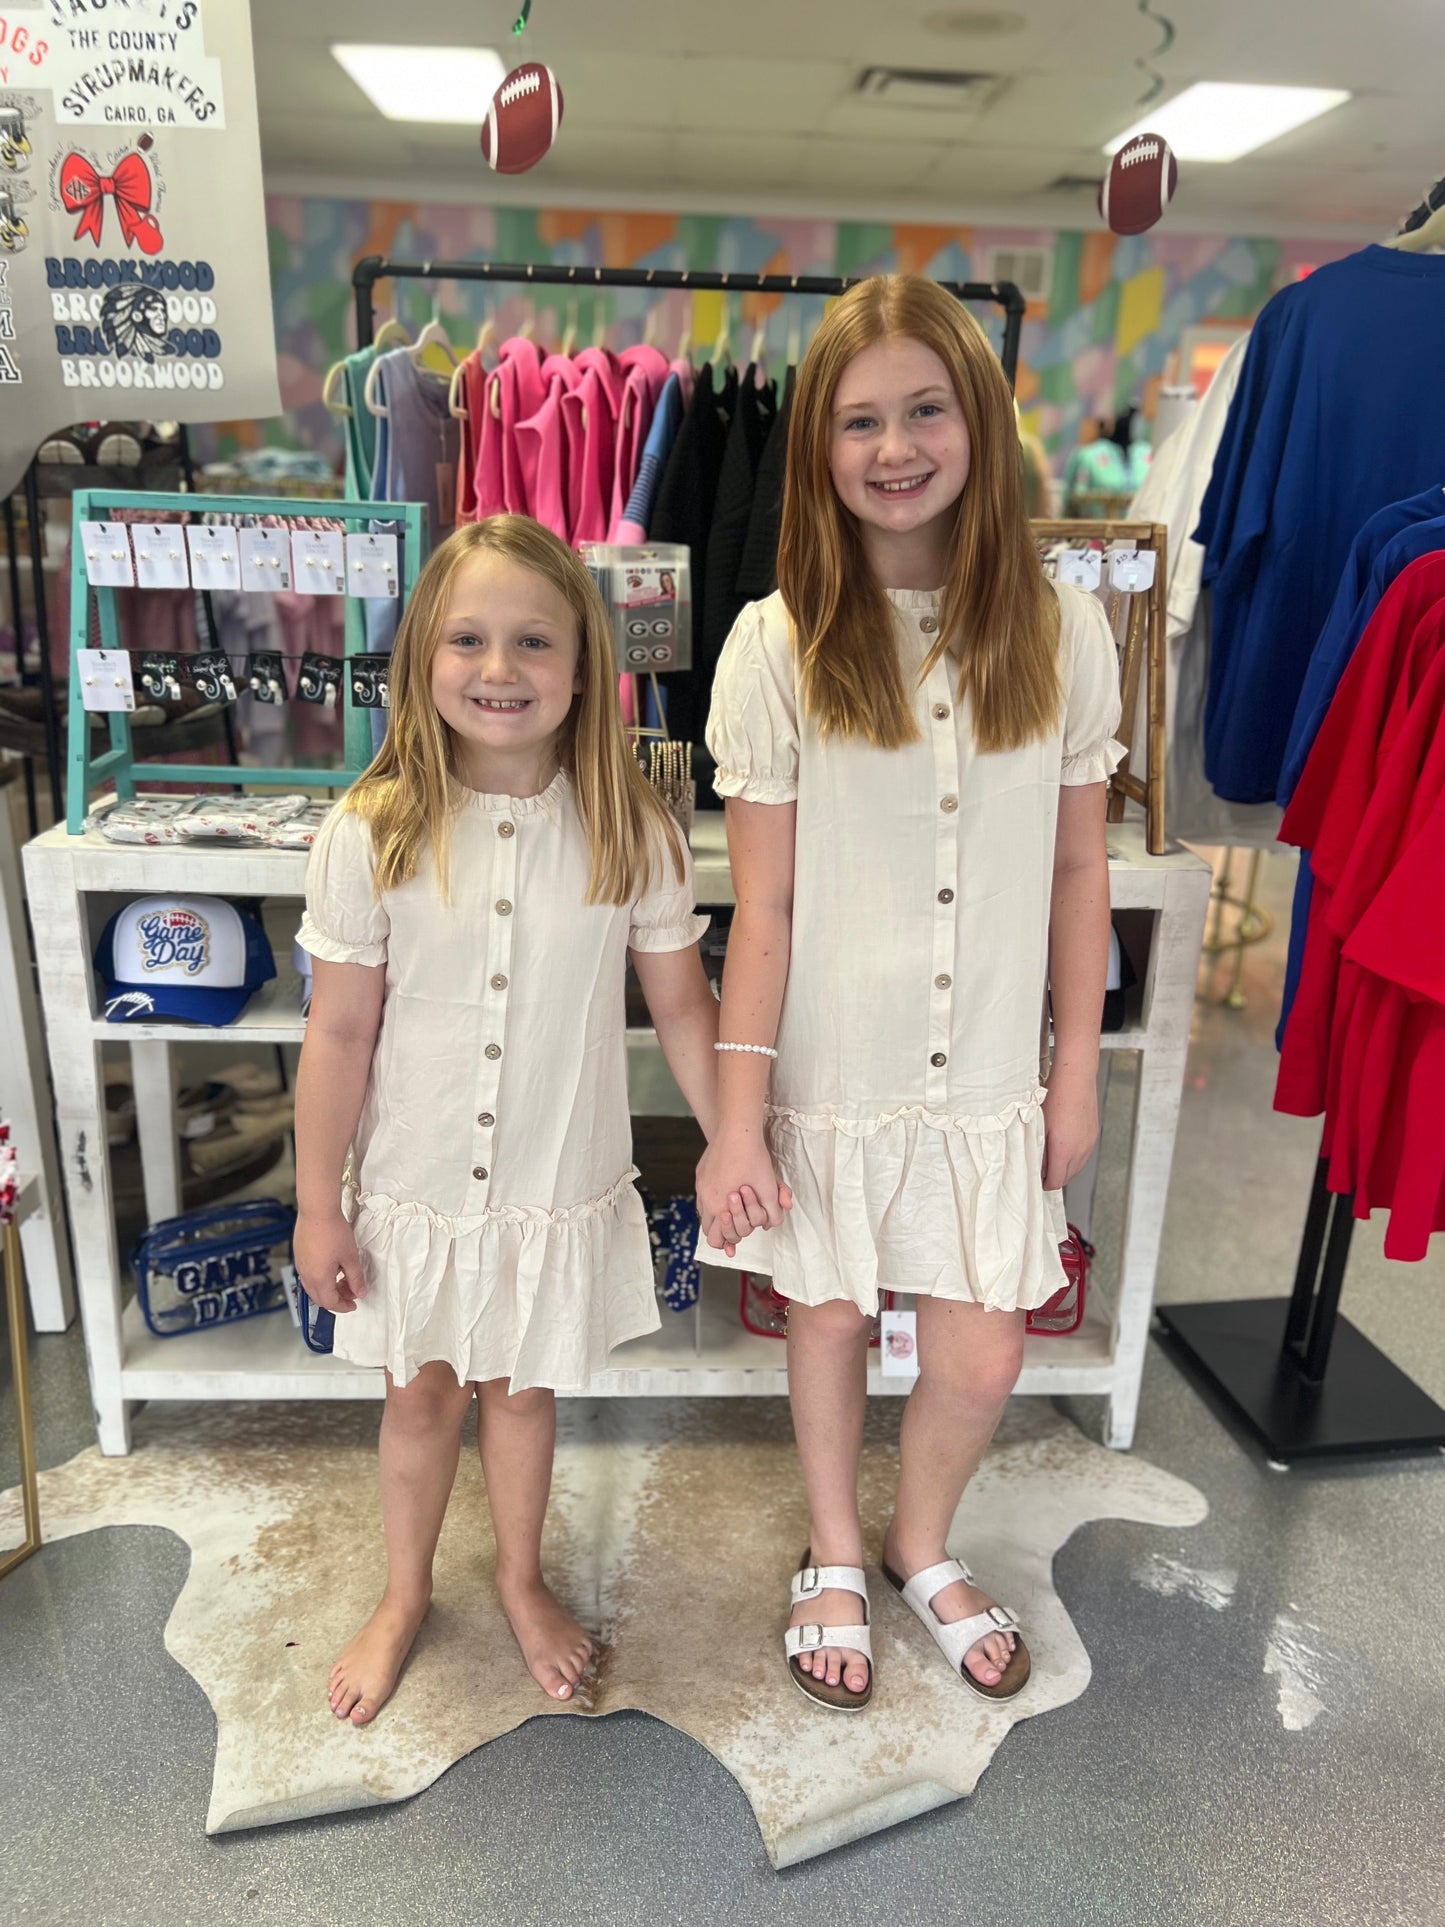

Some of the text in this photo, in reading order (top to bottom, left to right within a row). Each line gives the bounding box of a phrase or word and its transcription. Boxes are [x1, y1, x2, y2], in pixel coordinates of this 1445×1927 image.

[50, 0, 198, 30] JATS
[67, 29, 178, 51] THE COUNTY
[62, 58, 216, 122] SYRUPMAKERS
[104, 105, 176, 124] CAIRO, GA
[65, 178, 89, 201] CHS
[45, 257, 214, 292] BROOKWOOD
[51, 292, 217, 325] BROOOD
[55, 325, 221, 358] BROOOD
[61, 359, 224, 390] BROOKWOOD
[141, 915, 205, 949] Game
[146, 940, 204, 972] Day
[173, 1246, 272, 1296] GAME
[192, 1282, 261, 1326] DAY
